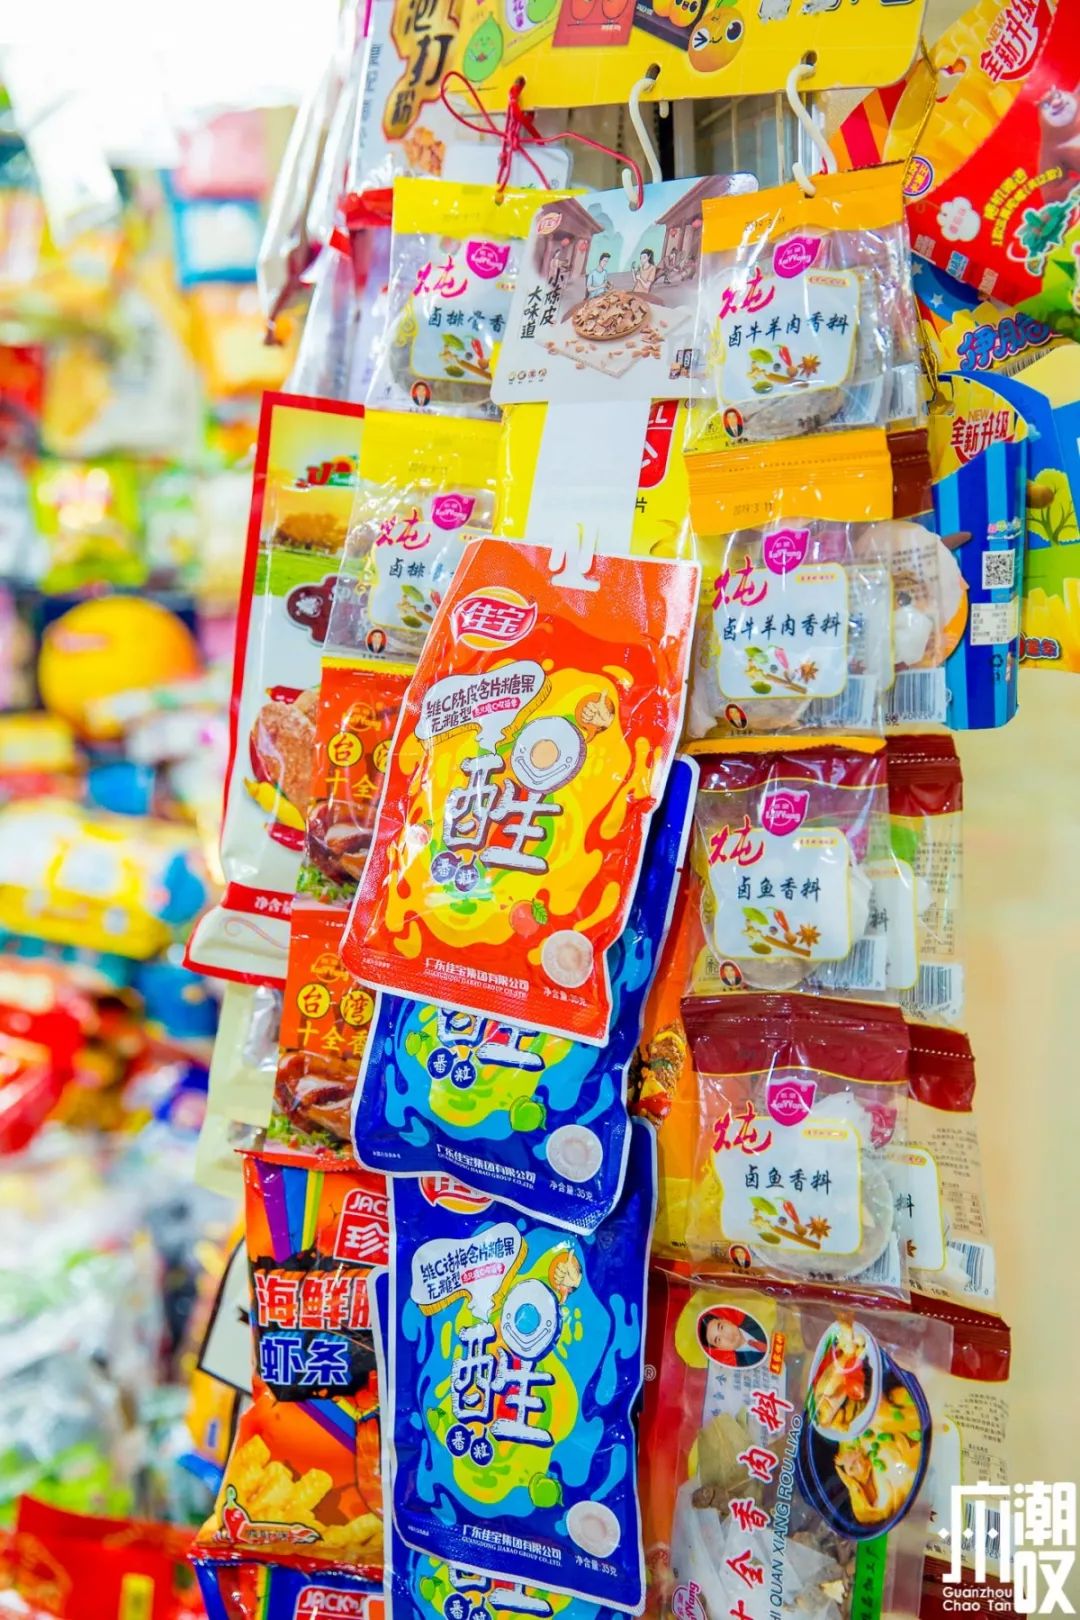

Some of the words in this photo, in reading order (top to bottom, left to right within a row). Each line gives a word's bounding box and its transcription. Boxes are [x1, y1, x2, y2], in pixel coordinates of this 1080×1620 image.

[520, 286, 544, 339] 大味道
[728, 311, 850, 347] 卤牛羊肉香料
[649, 405, 668, 424] L
[950, 411, 1010, 453] 全新升级
[463, 601, 526, 634] 佳宝
[723, 612, 841, 641] 卤牛羊肉香料
[737, 876, 822, 902] 卤鱼香料
[424, 956, 530, 992] 广东佳宝集团有限公司
[436, 1143, 537, 1184] 广东佳宝集团有限公司
[744, 1163, 832, 1196] 卤鱼香料
[345, 1223, 389, 1258] 珍
[260, 1336, 350, 1386] 虾条
[786, 1415, 803, 1458] LIAO
[778, 1458, 795, 1500] ROU
[462, 1524, 563, 1560] 广东佳宝集团有限公司
[773, 1503, 791, 1556] XIANG
[770, 1559, 784, 1607] QUAN
